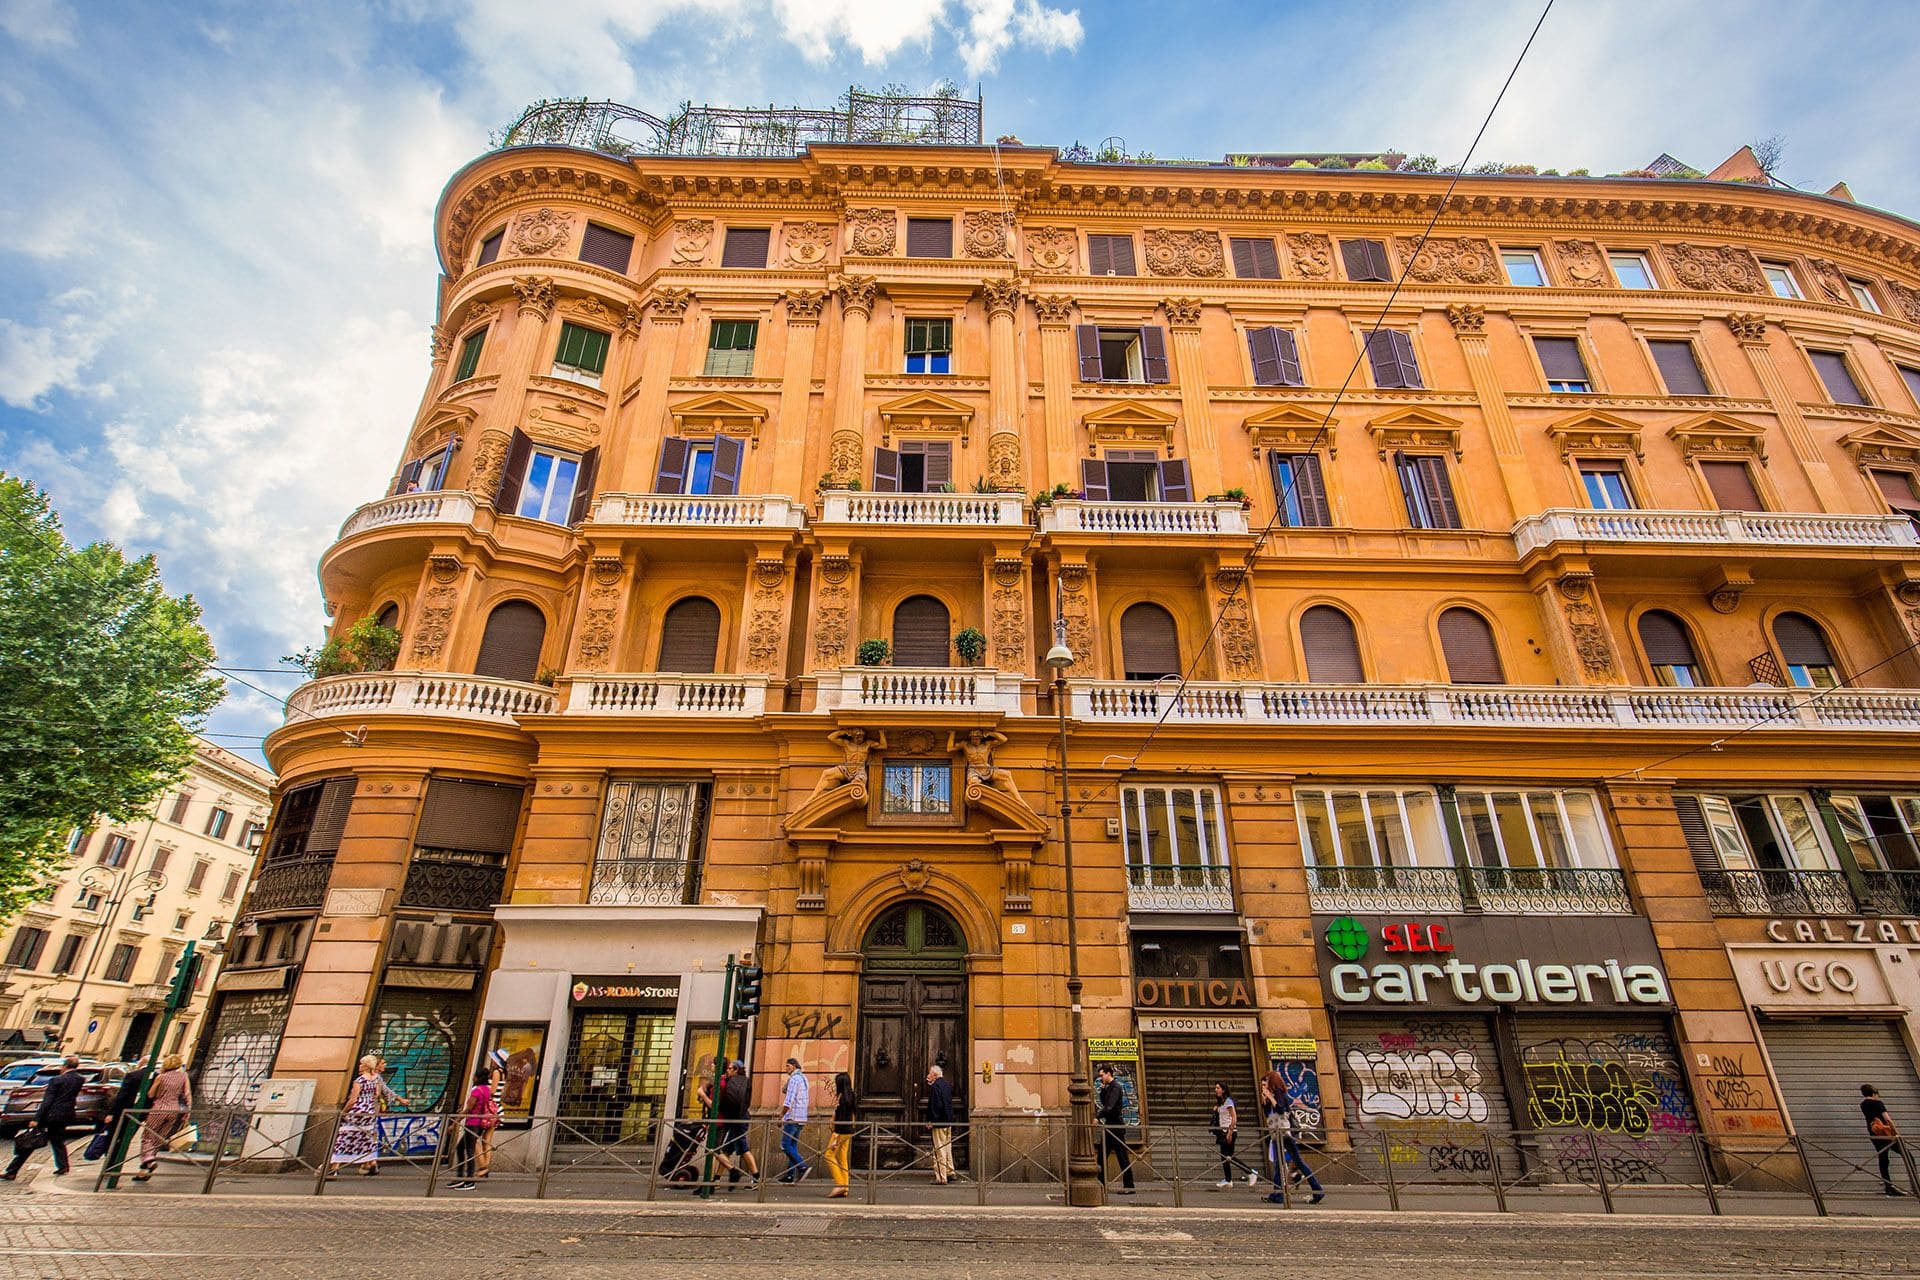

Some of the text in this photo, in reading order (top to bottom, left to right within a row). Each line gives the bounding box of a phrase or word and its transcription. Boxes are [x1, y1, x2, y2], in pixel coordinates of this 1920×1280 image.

[392, 923, 488, 963] NIK
[1381, 924, 1455, 952] SEC
[1330, 958, 1671, 1003] cartoleria
[1761, 960, 1858, 993] UGO
[1137, 978, 1252, 1007] OTTICA
[1089, 1039, 1137, 1047] Kodak Kiosk
